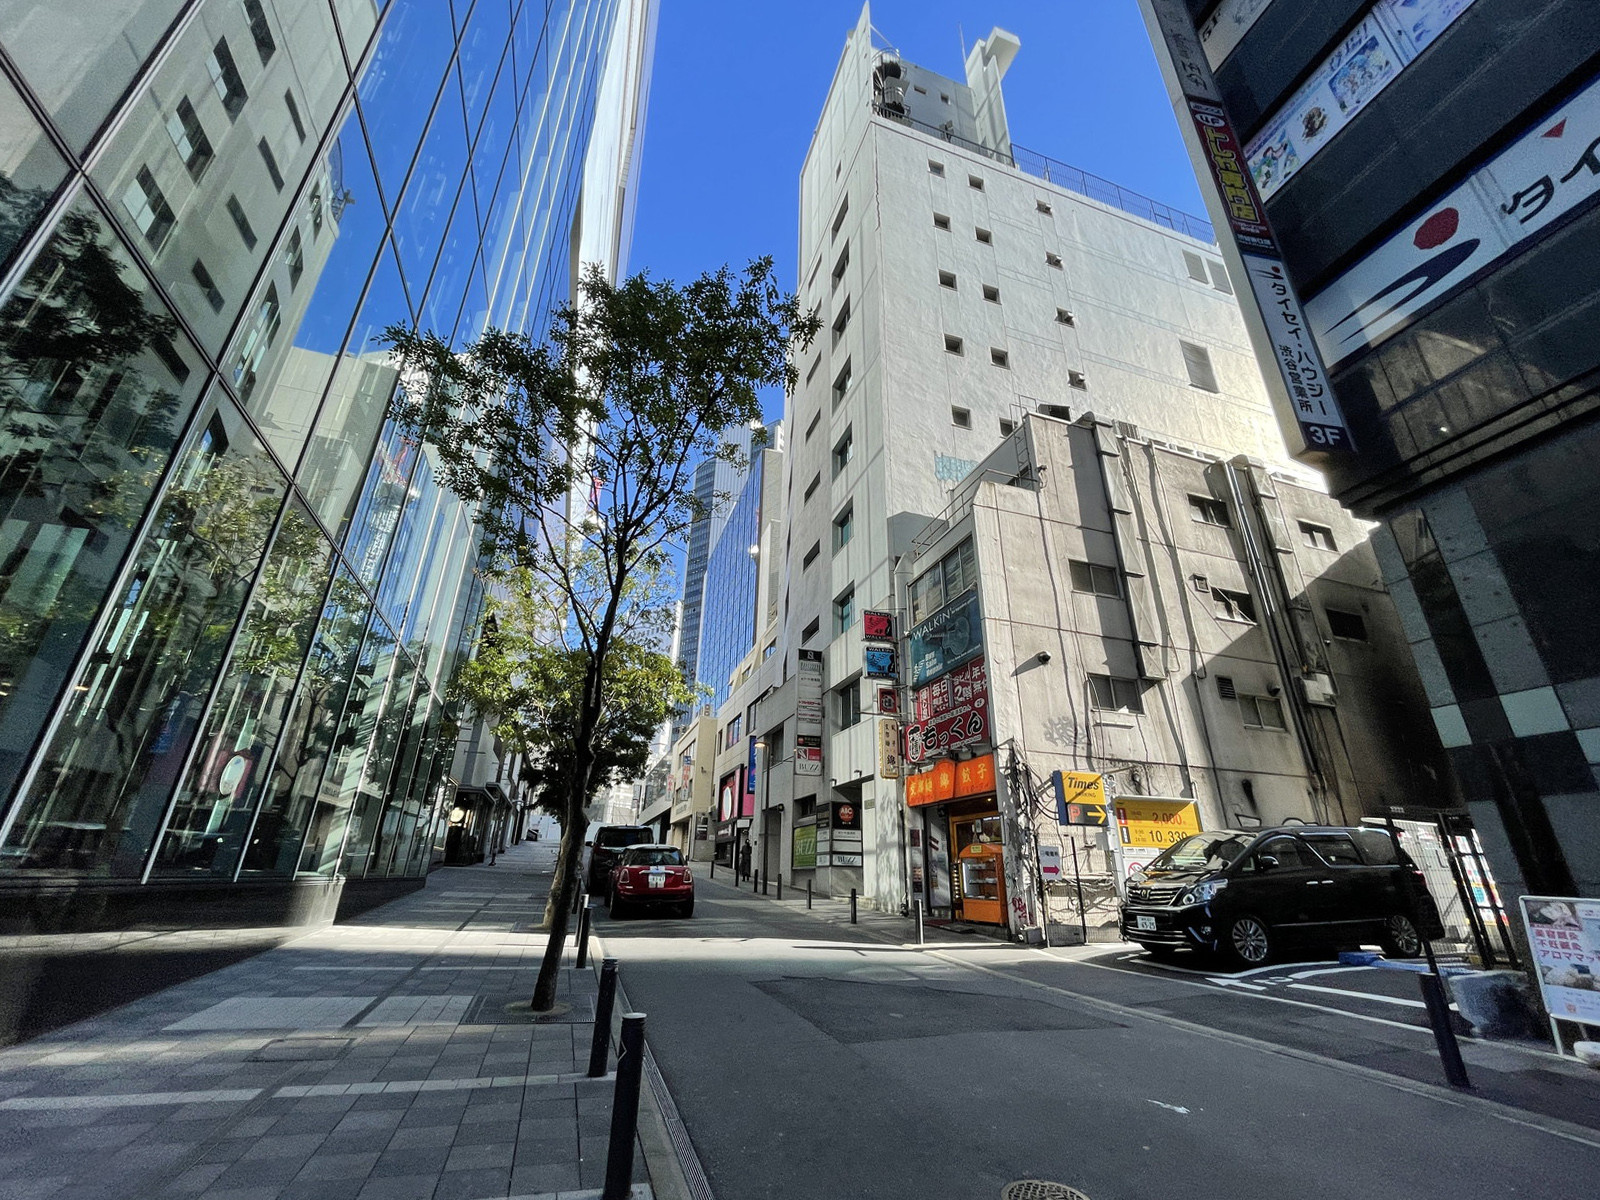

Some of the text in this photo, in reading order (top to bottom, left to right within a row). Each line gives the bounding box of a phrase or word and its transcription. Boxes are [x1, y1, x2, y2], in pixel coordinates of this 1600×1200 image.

[1271, 282, 1327, 416] タイセイ・ハウジー
[1278, 343, 1313, 414] 渋谷営業所
[1309, 425, 1341, 446] 3F
[932, 680, 948, 697] 毎日
[921, 710, 984, 752] もっくん
[961, 763, 988, 784] 餃子
[1068, 777, 1099, 790] Times
[1152, 811, 1182, 825] 2,000
[1149, 830, 1163, 843] 10
